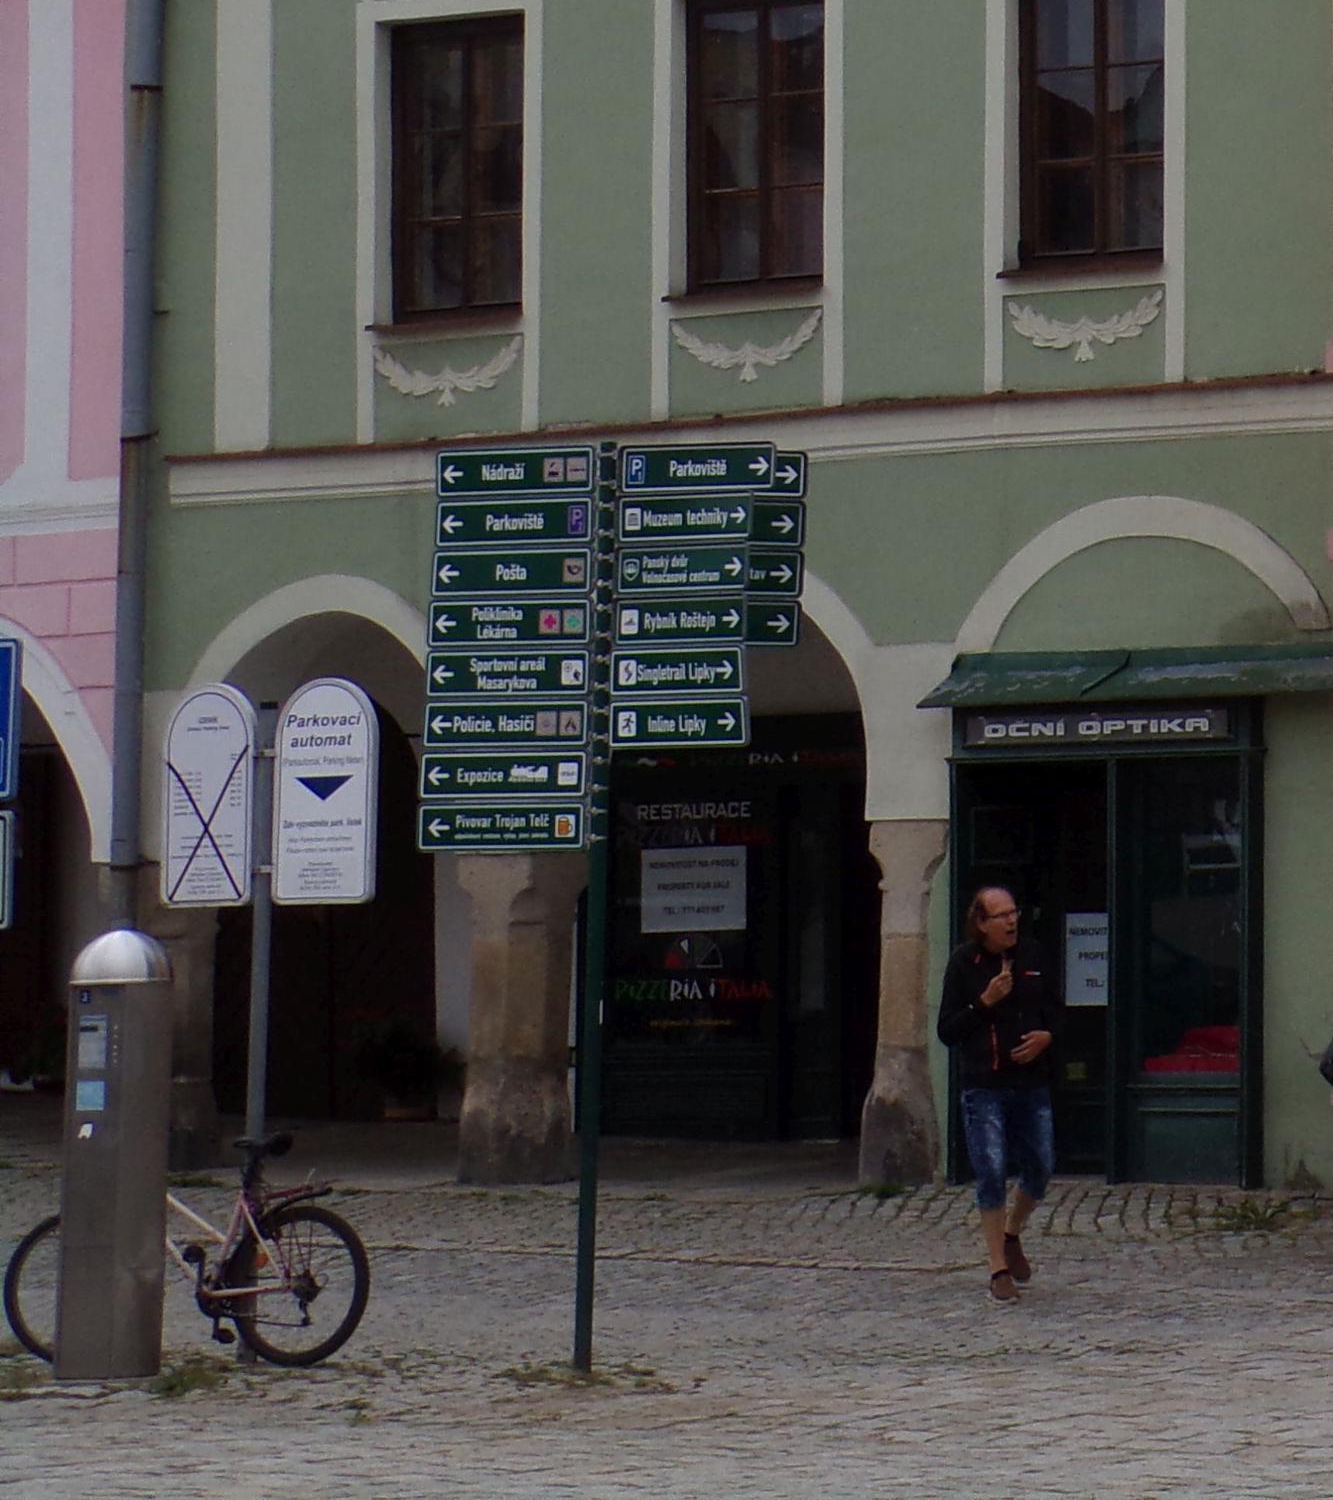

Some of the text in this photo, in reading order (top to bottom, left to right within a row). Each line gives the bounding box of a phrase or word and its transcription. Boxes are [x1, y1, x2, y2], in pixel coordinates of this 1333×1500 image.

[481, 462, 526, 481] Nádraží
[669, 459, 727, 478] Parkoviště
[485, 513, 545, 532] Parkoviště
[643, 507, 729, 528] Muzeum techniky
[495, 563, 527, 582] Pošta
[642, 555, 670, 573] Panský
[689, 570, 720, 583] centrum
[471, 607, 523, 622] Poliklinika
[643, 610, 716, 633] Rybník Roštejn
[477, 623, 518, 640] Lékárna
[469, 656, 546, 676] Sportovní areál
[637, 662, 718, 686] Singletrail Lipky
[477, 674, 538, 693] Masarykova
[286, 711, 362, 728] Parkovací
[498, 714, 535, 732] Hasiči
[647, 714, 707, 737] Inline Lipky
[983, 717, 1211, 739] OČNÍ OPTIKA
[290, 733, 352, 749] automat
[456, 767, 504, 787] Expozice
[637, 800, 752, 821] RESTAURACE
[455, 813, 550, 831] Pivovar Trojan Telč
